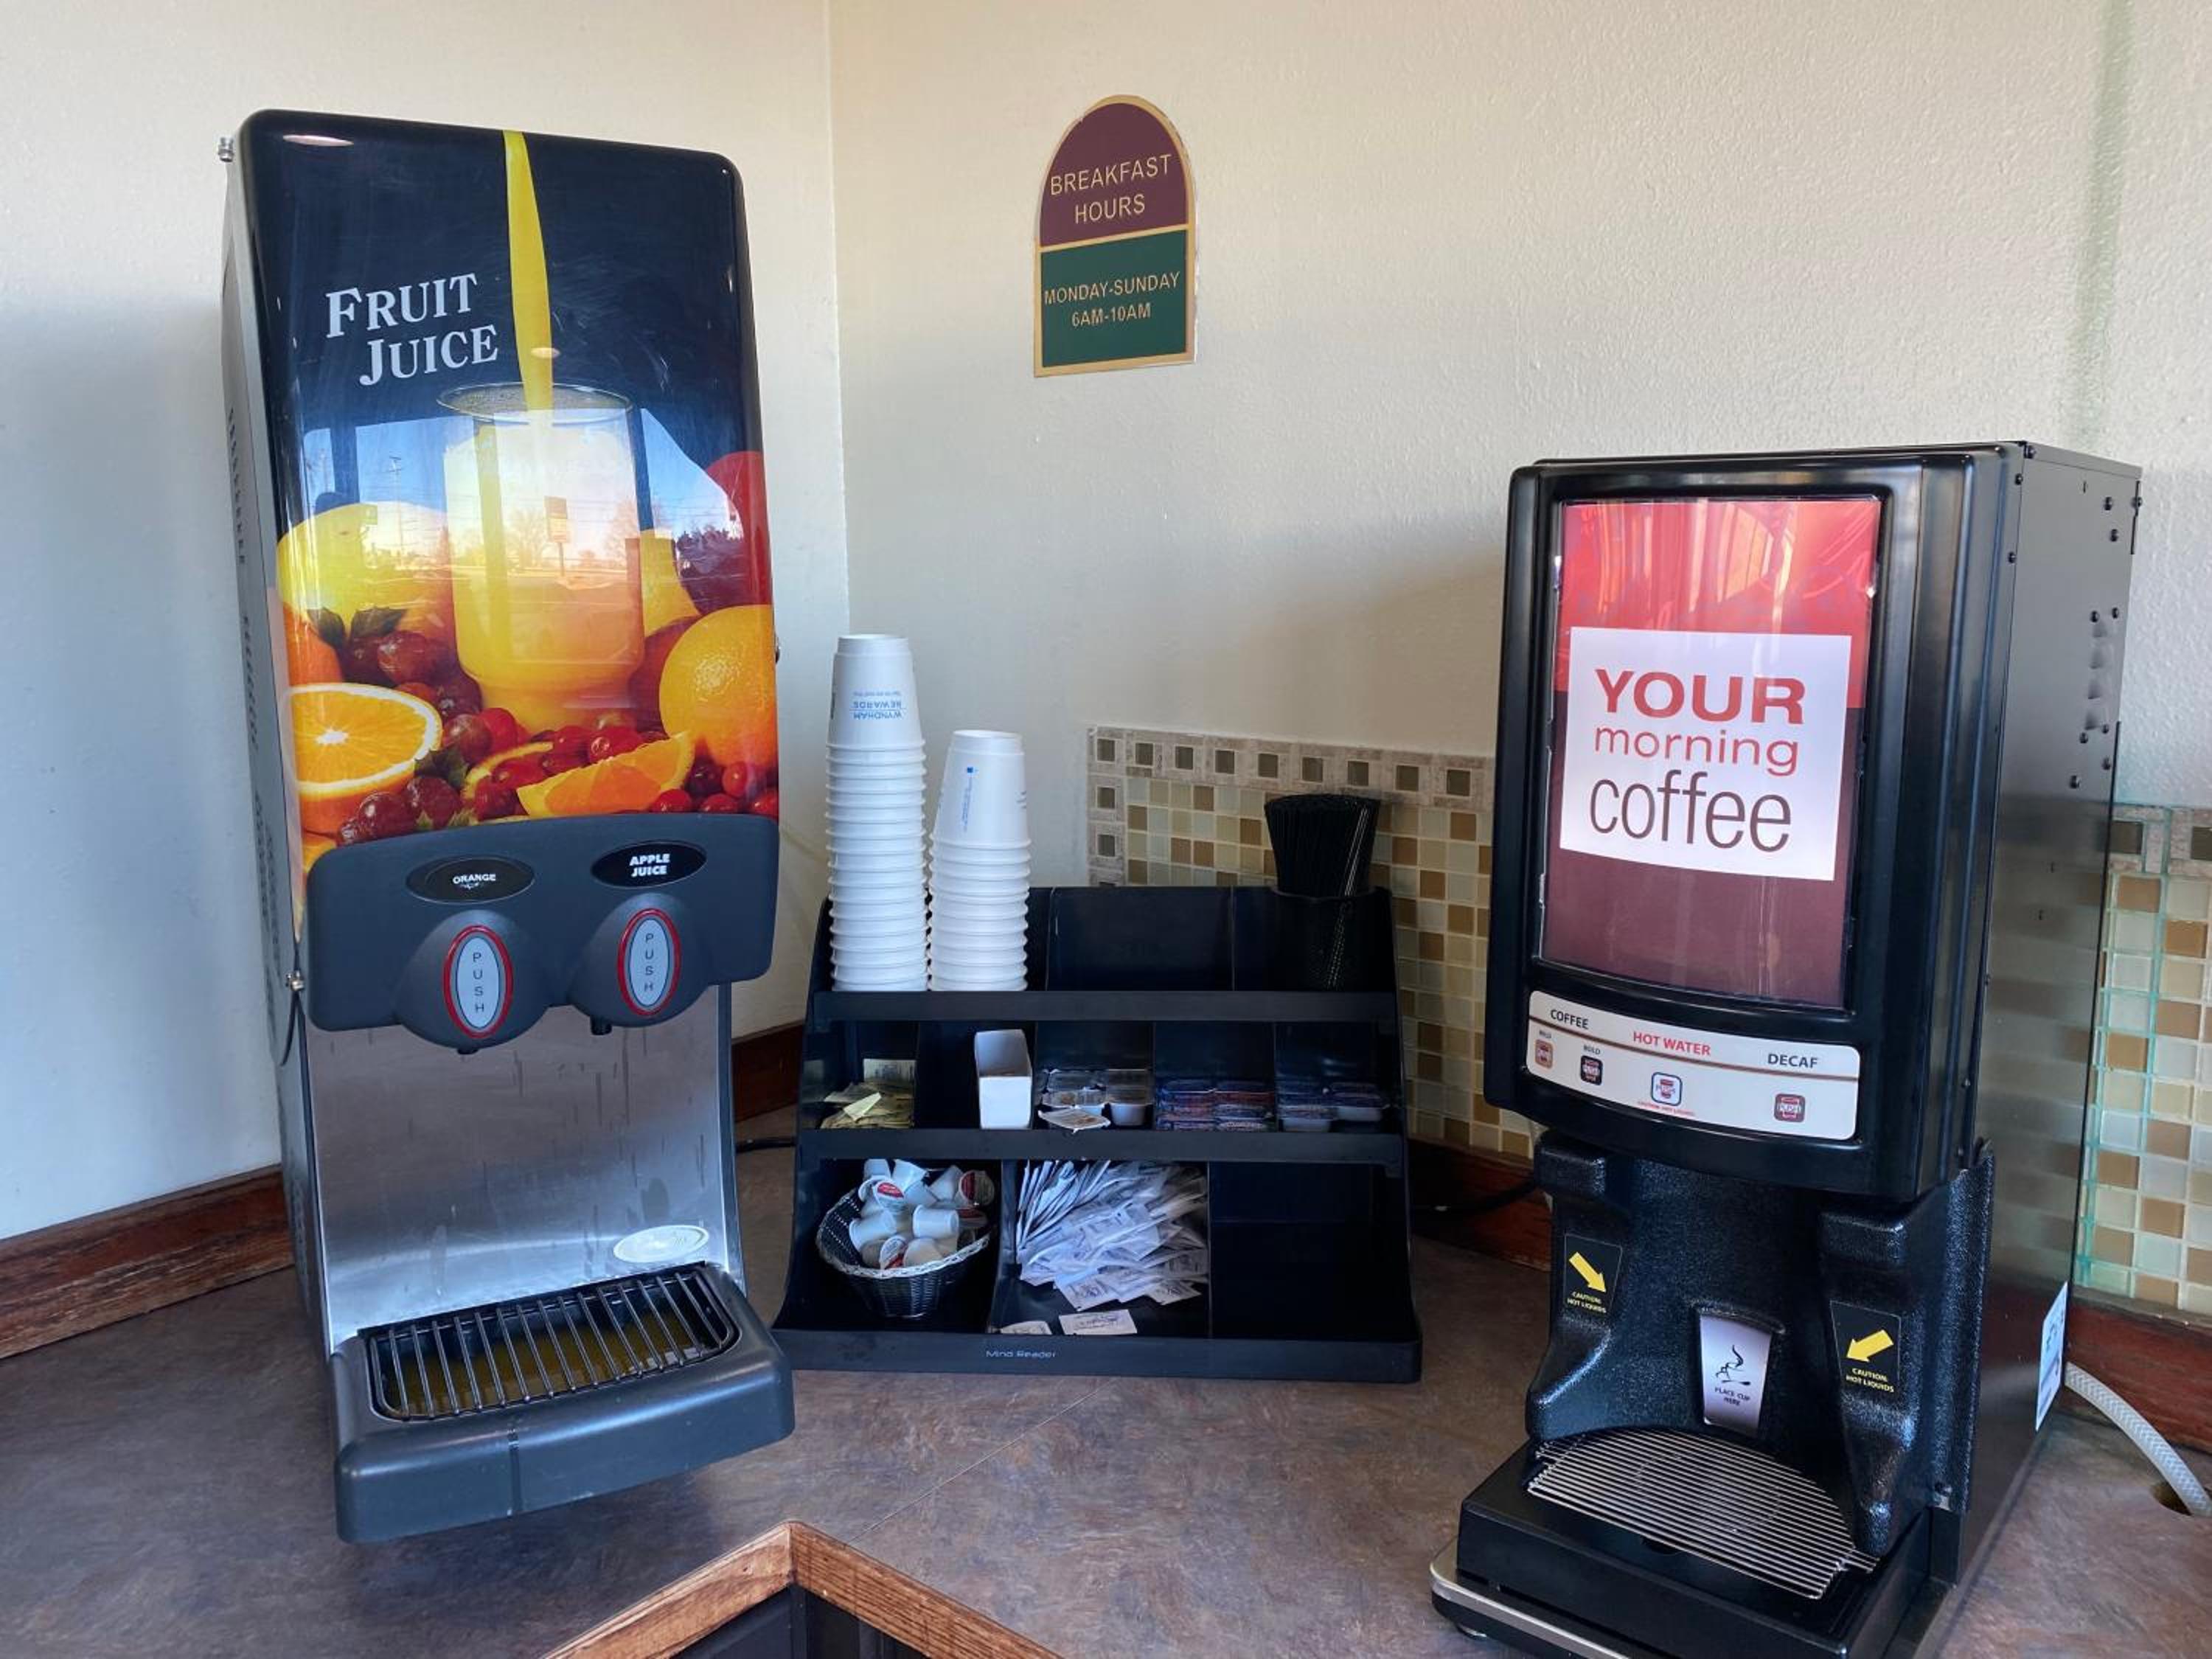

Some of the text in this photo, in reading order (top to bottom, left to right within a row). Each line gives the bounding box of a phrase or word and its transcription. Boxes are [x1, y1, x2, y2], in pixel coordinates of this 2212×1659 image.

[1050, 153, 1172, 195] BREAKFAST
[1074, 193, 1145, 224] HOURS
[1043, 271, 1180, 305] MONDAY-SUNDAY
[325, 273, 478, 338] FRUIT
[1071, 302, 1151, 327] 6AM-10AM
[359, 324, 499, 386] JUICE
[1595, 669, 1806, 724] YOUR
[1594, 726, 1798, 777] morning
[1590, 769, 1792, 852] coffee
[629, 853, 670, 866] APPLE
[631, 865, 668, 877] JUICE
[452, 874, 496, 884] ORANGE
[644, 933, 655, 992] PUSH
[473, 951, 485, 1013] PUSH
[1550, 1009, 1589, 1030] COFFEE
[1632, 1031, 1711, 1056] HOT WATER
[1767, 1053, 1819, 1068] DECAF
[1863, 1378, 1895, 1393] LIQUIDS
